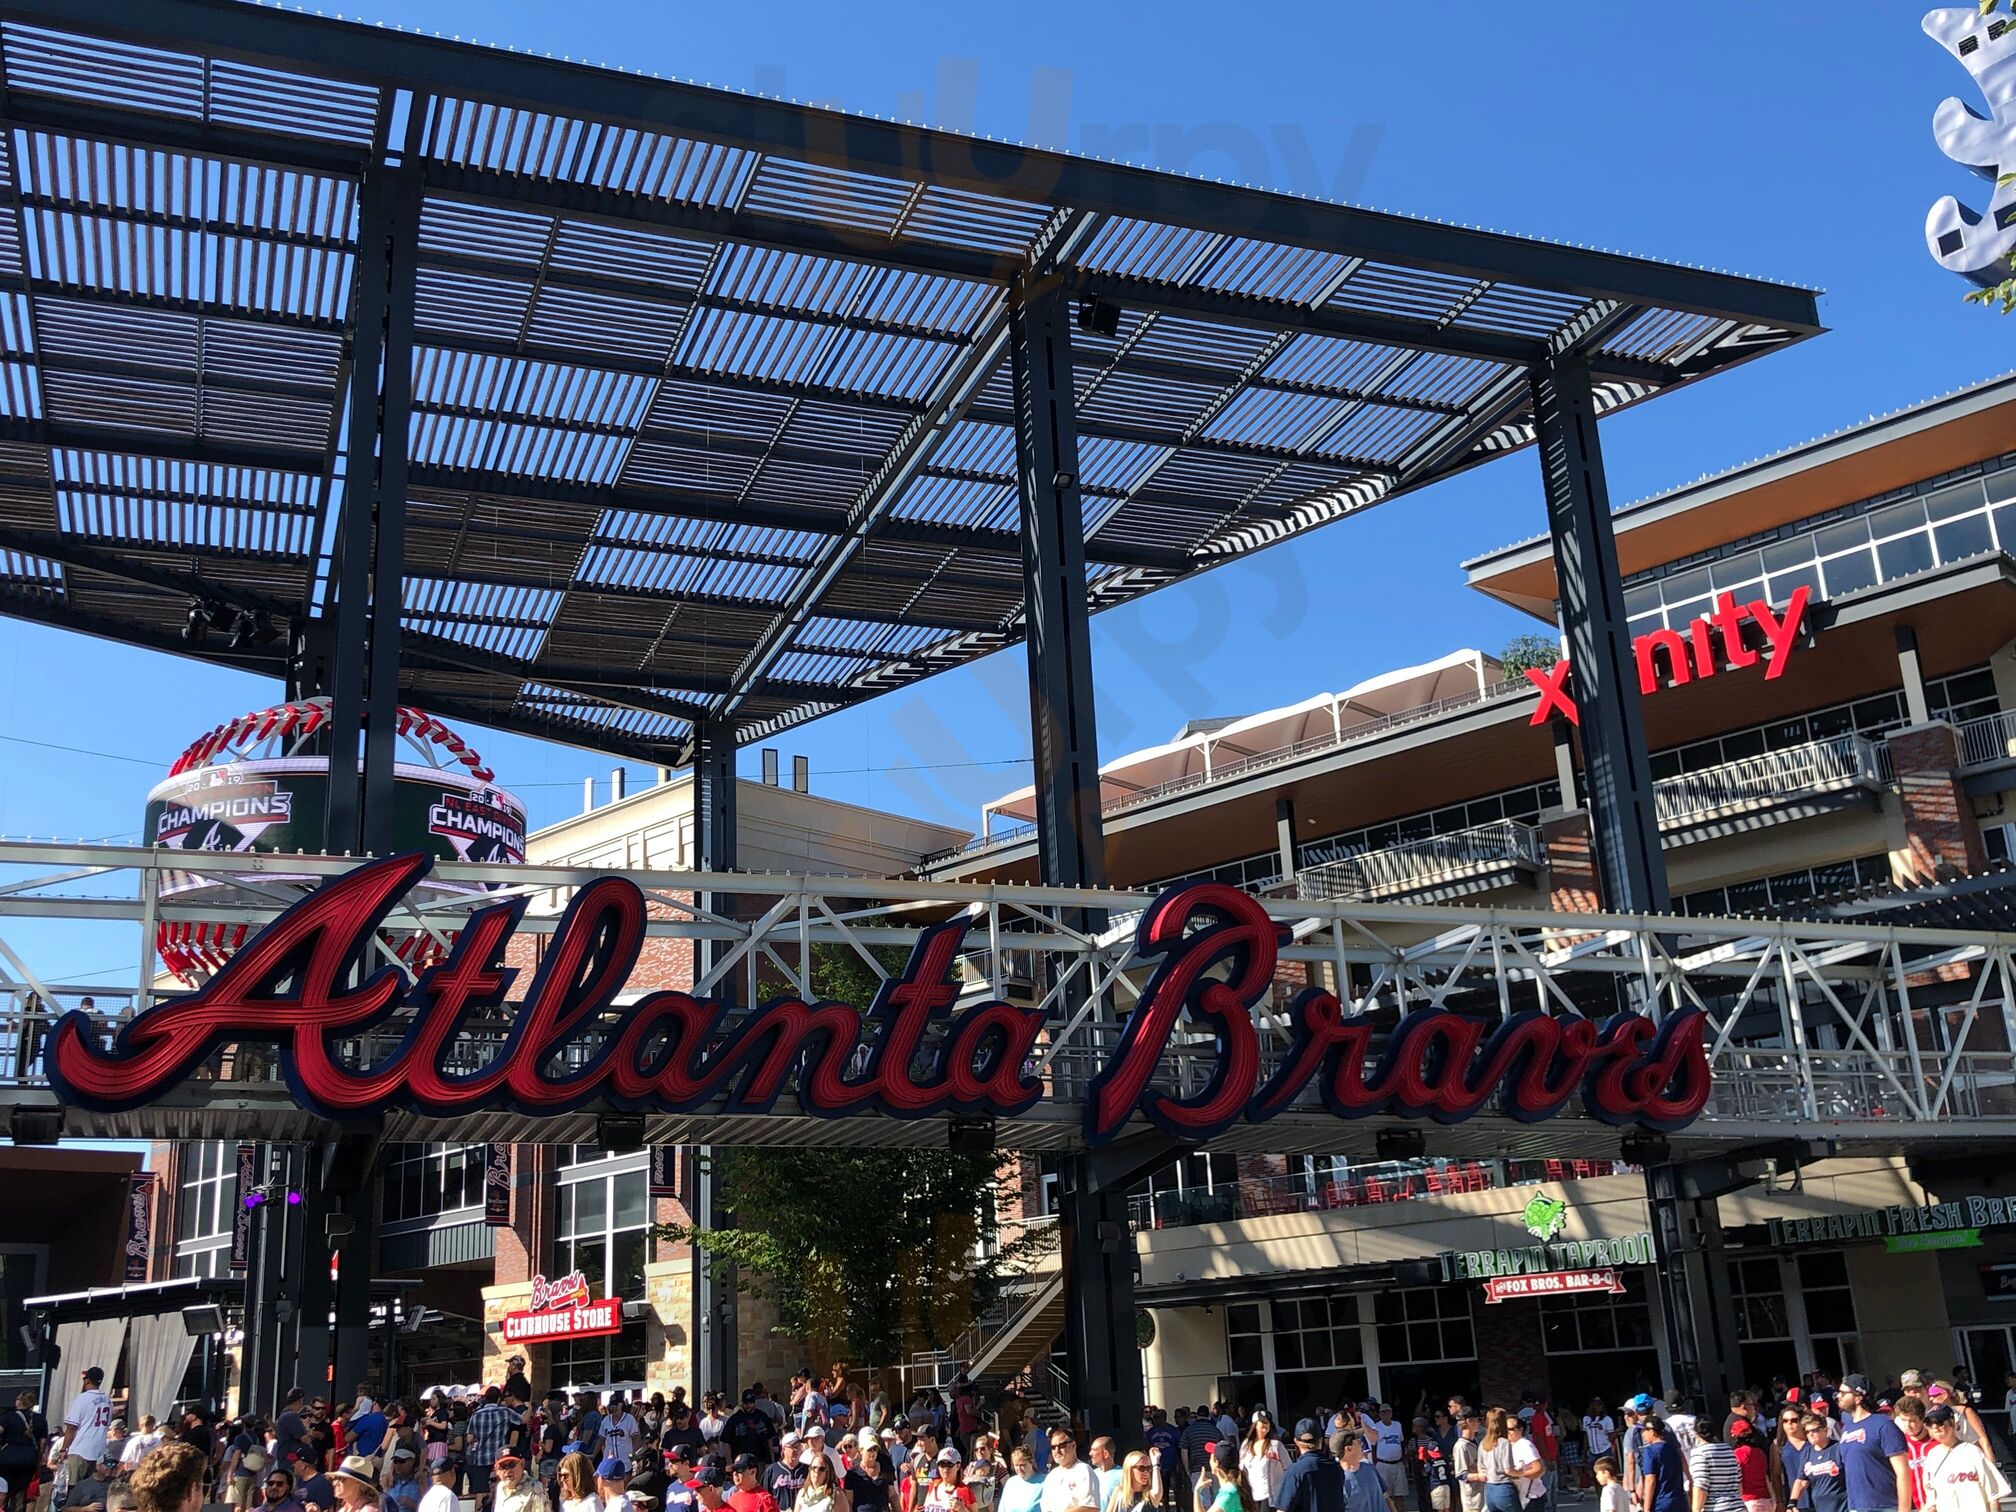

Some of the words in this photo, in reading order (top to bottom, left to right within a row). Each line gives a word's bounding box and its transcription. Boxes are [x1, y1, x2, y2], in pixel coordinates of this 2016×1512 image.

[1525, 585, 1812, 727] xnity
[158, 795, 289, 834] CHAMPIONS
[431, 806, 526, 855] CHAMPIONS
[45, 852, 1051, 1120] Atlanta
[1085, 881, 1712, 1142] Braves
[126, 1192, 149, 1261] Braves
[1762, 1212, 1882, 1247] TERRAPIN
[1885, 1201, 1965, 1235] FRESH
[1435, 1246, 1548, 1282] TERRAPIN
[1506, 1276, 1527, 1292] FOX
[1531, 1275, 1562, 1291] BROS.
[1565, 1271, 1614, 1288] BAR-B-Q
[530, 1269, 581, 1312] Braves
[506, 1312, 571, 1339] CLUBHOUSE
[573, 1306, 613, 1330] STORE
[94, 1406, 111, 1428] 13
